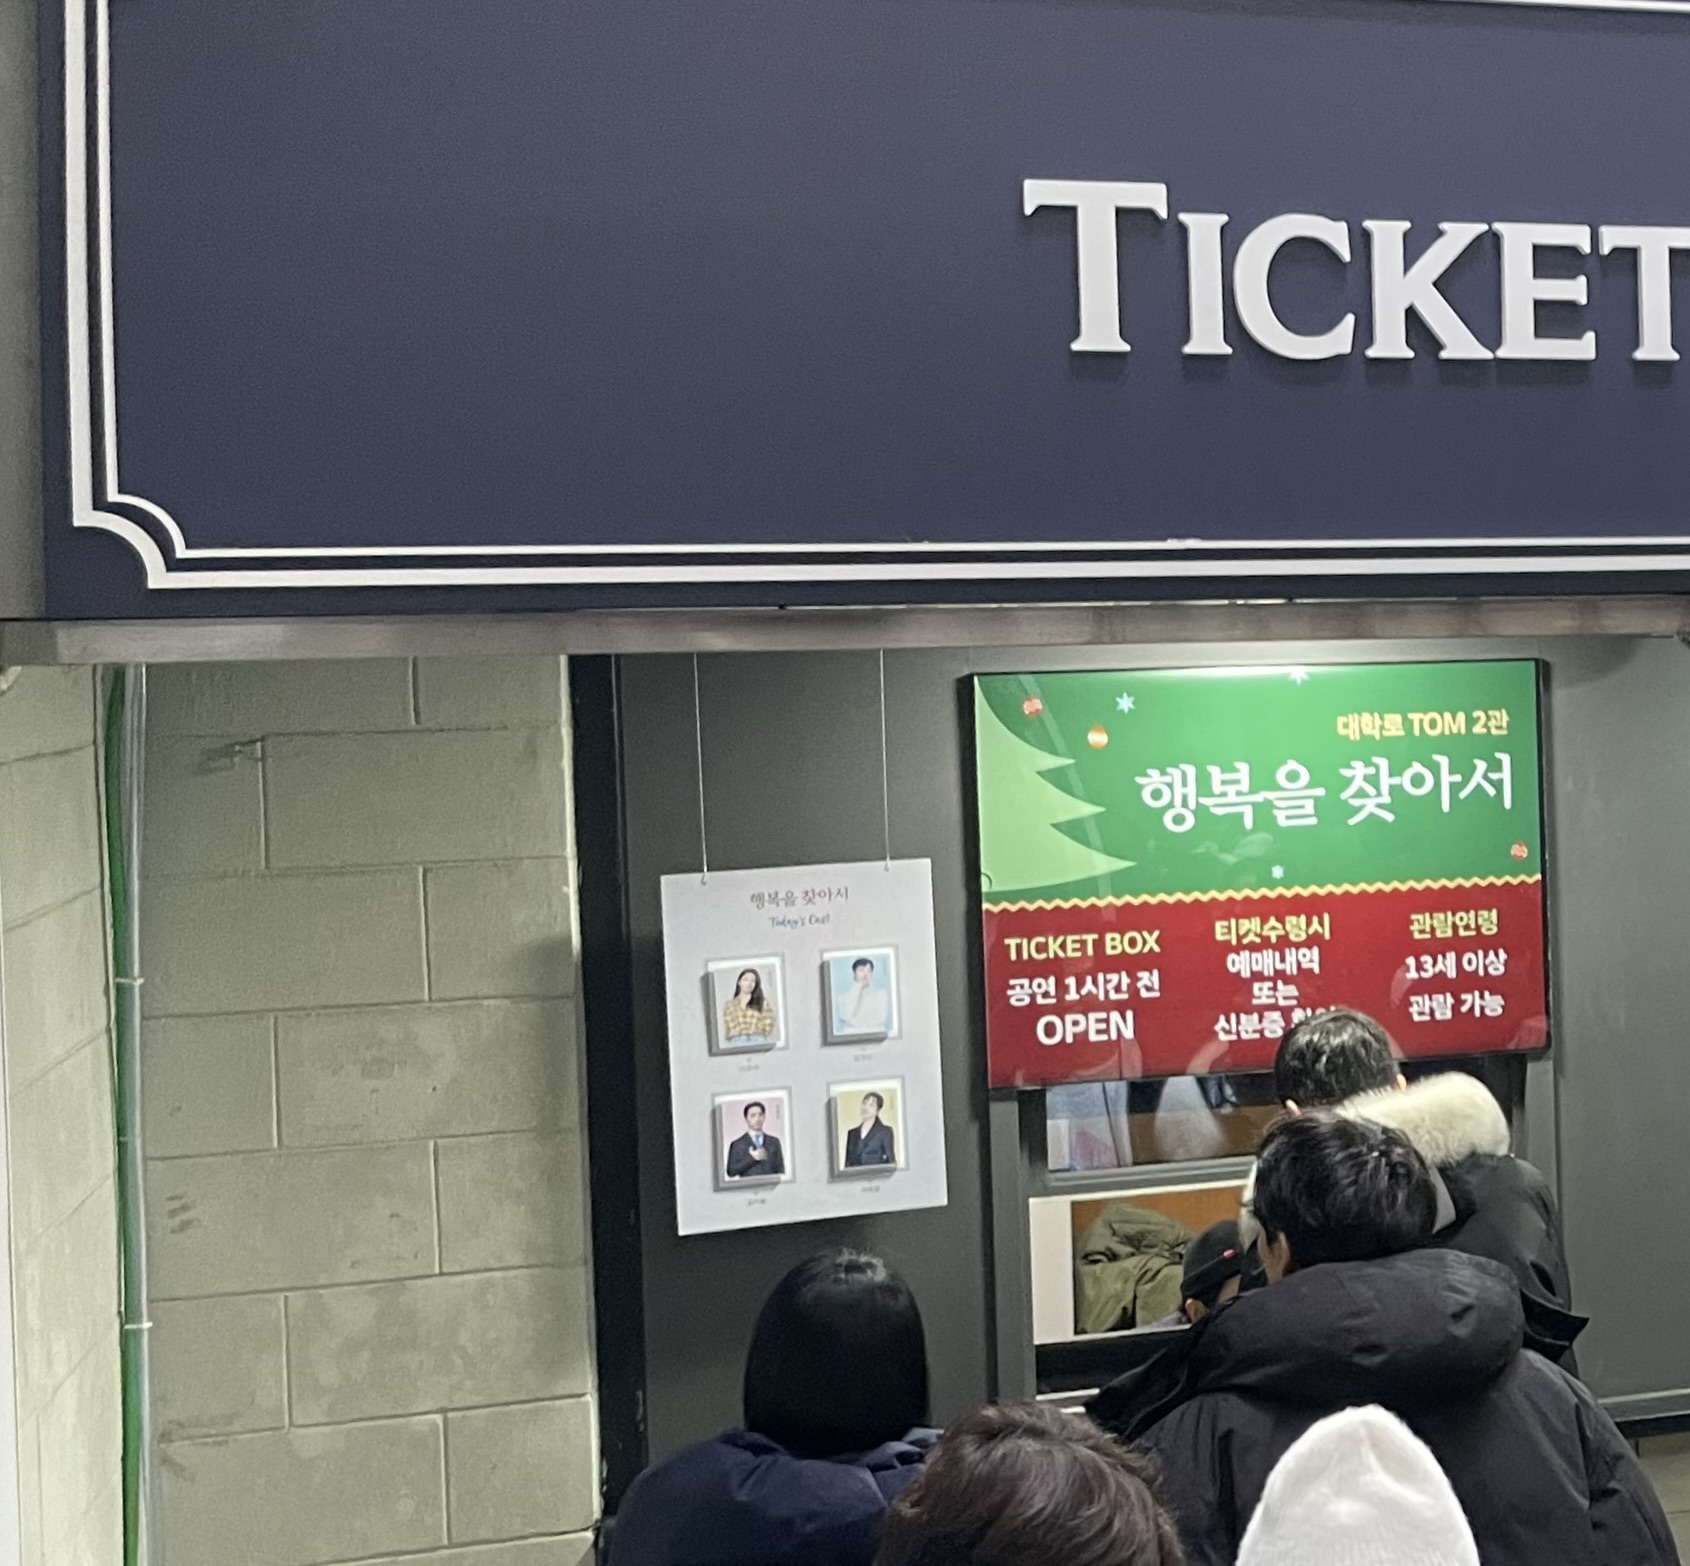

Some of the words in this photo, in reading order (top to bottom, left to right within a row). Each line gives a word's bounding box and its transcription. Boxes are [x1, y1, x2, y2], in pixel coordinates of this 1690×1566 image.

[1336, 711, 1405, 741] 대학로
[1407, 711, 1467, 737] TOM
[1471, 708, 1510, 736] 2관
[1134, 758, 1327, 834] 행복을
[1338, 751, 1513, 826] 찾아서
[1213, 911, 1331, 946] 티켓수령시
[1409, 908, 1499, 940] 관람연령
[1003, 933, 1099, 961] TICKET
[1104, 929, 1161, 956] BOX
[1226, 945, 1321, 978] 예매내역
[1404, 950, 1458, 980] 13세
[1461, 947, 1508, 977] 이상
[1006, 975, 1058, 1007] 공연
[1063, 970, 1131, 1002] 1시간
[1136, 967, 1162, 999] 전
[1251, 979, 1300, 1006] 또는
[1408, 991, 1455, 1023] 관람
[1459, 989, 1506, 1018] 가능
[1035, 1008, 1136, 1046] OPEN
[1213, 1010, 1286, 1042] 신분증
